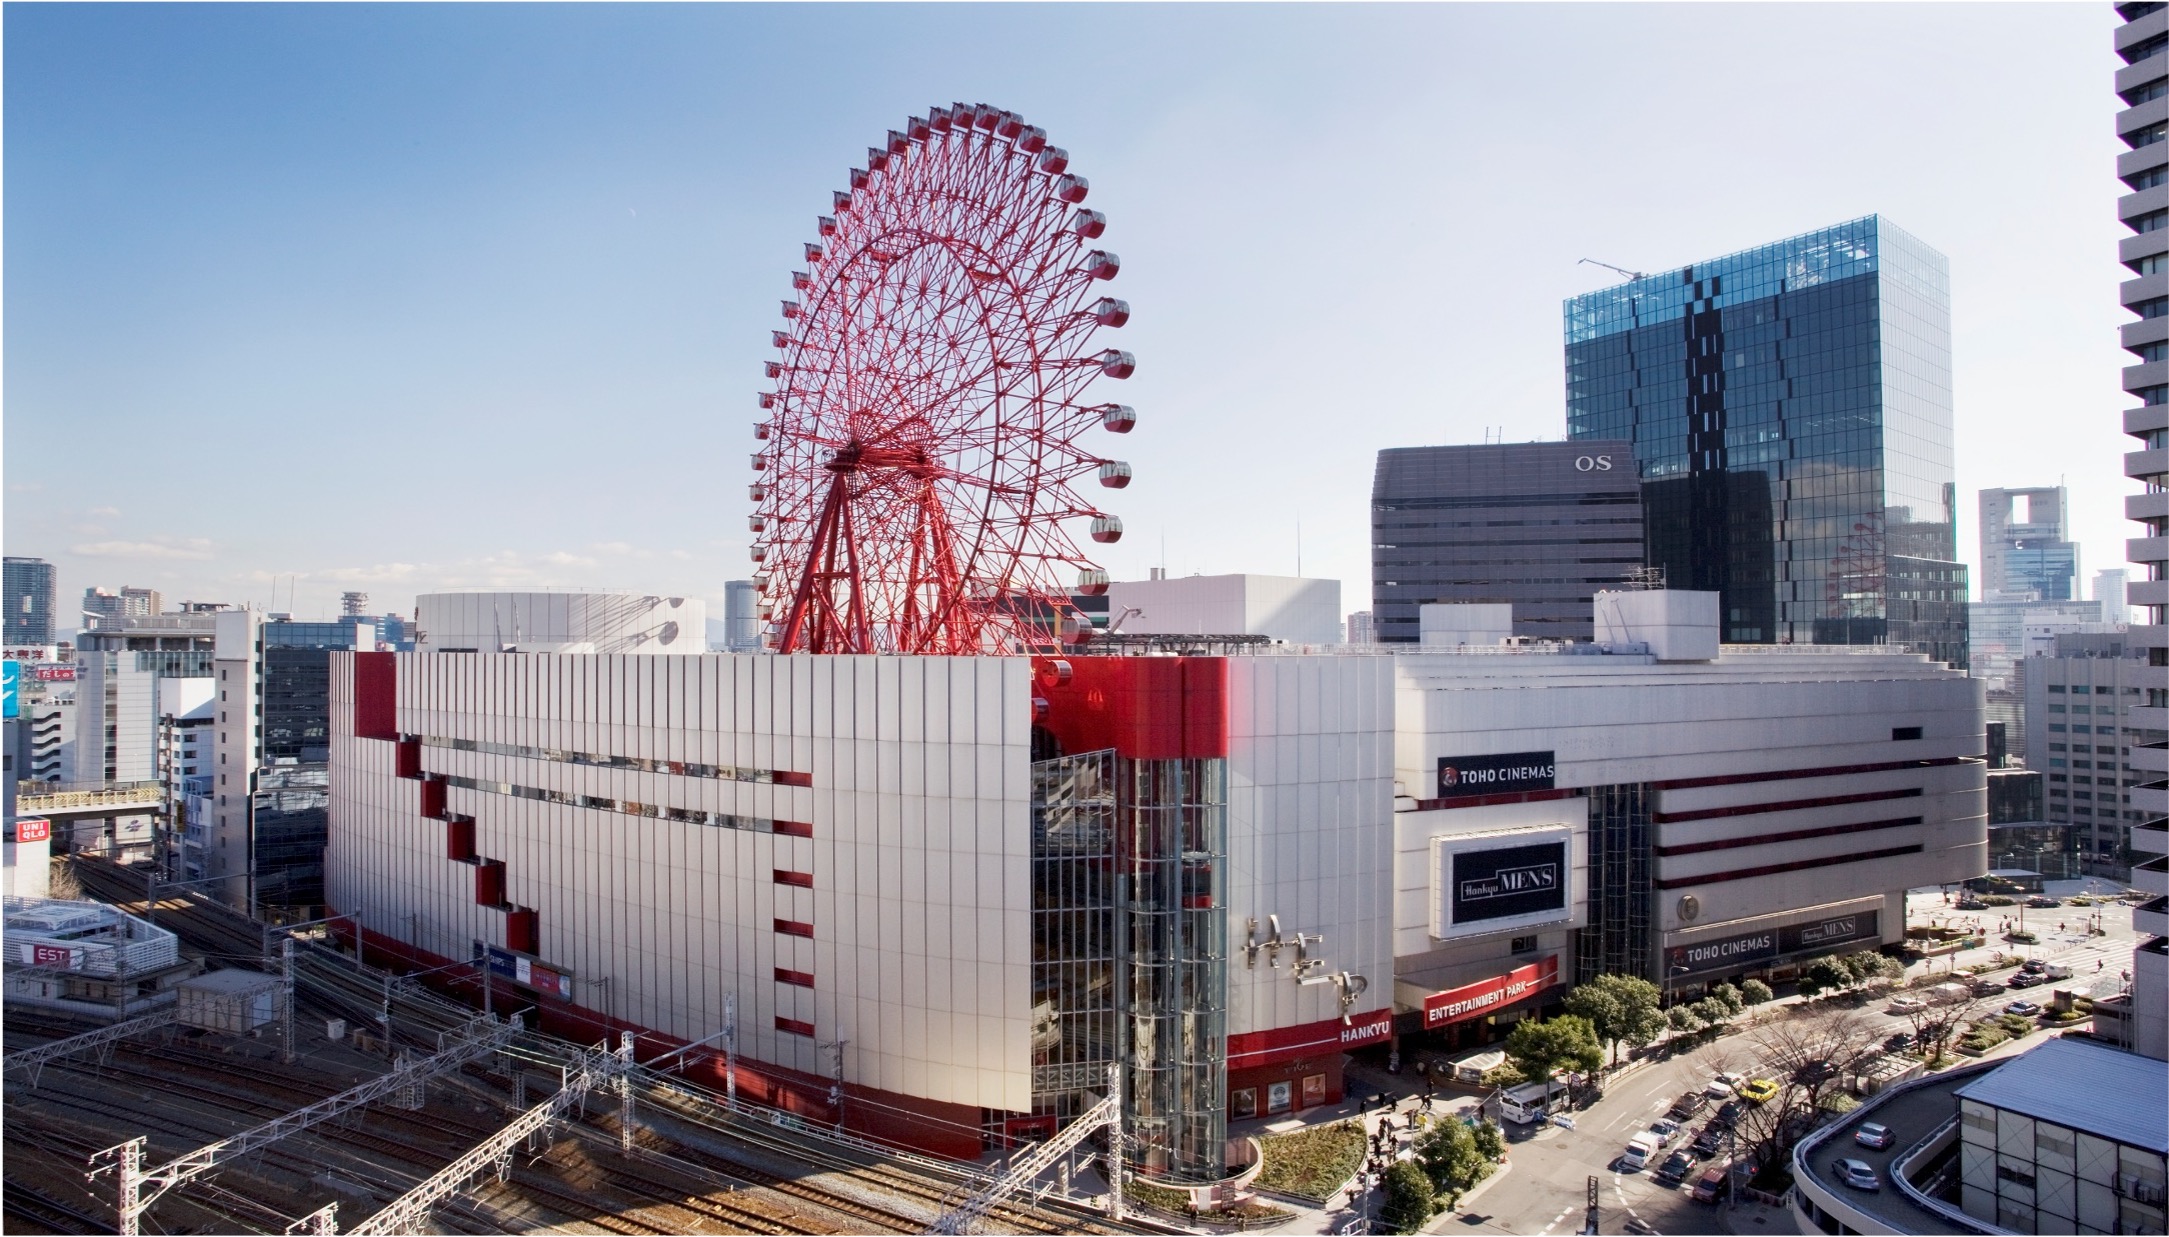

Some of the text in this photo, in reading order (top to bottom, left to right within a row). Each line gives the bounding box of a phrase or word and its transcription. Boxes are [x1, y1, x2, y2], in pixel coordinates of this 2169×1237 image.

[1575, 455, 1612, 472] OS
[1461, 765, 1554, 784] TOHO CINEMAS
[22, 830, 46, 839] QLO
[23, 822, 44, 831] UNI
[1465, 868, 1553, 897] Hankyu MENS
[1823, 919, 1854, 937] MENS
[38, 948, 66, 961] EST
[1687, 935, 1770, 962] TOHO CINEMAS
[1429, 980, 1527, 1022] ENTERTAINMENT PARK
[1341, 1021, 1390, 1042] HANKYU
